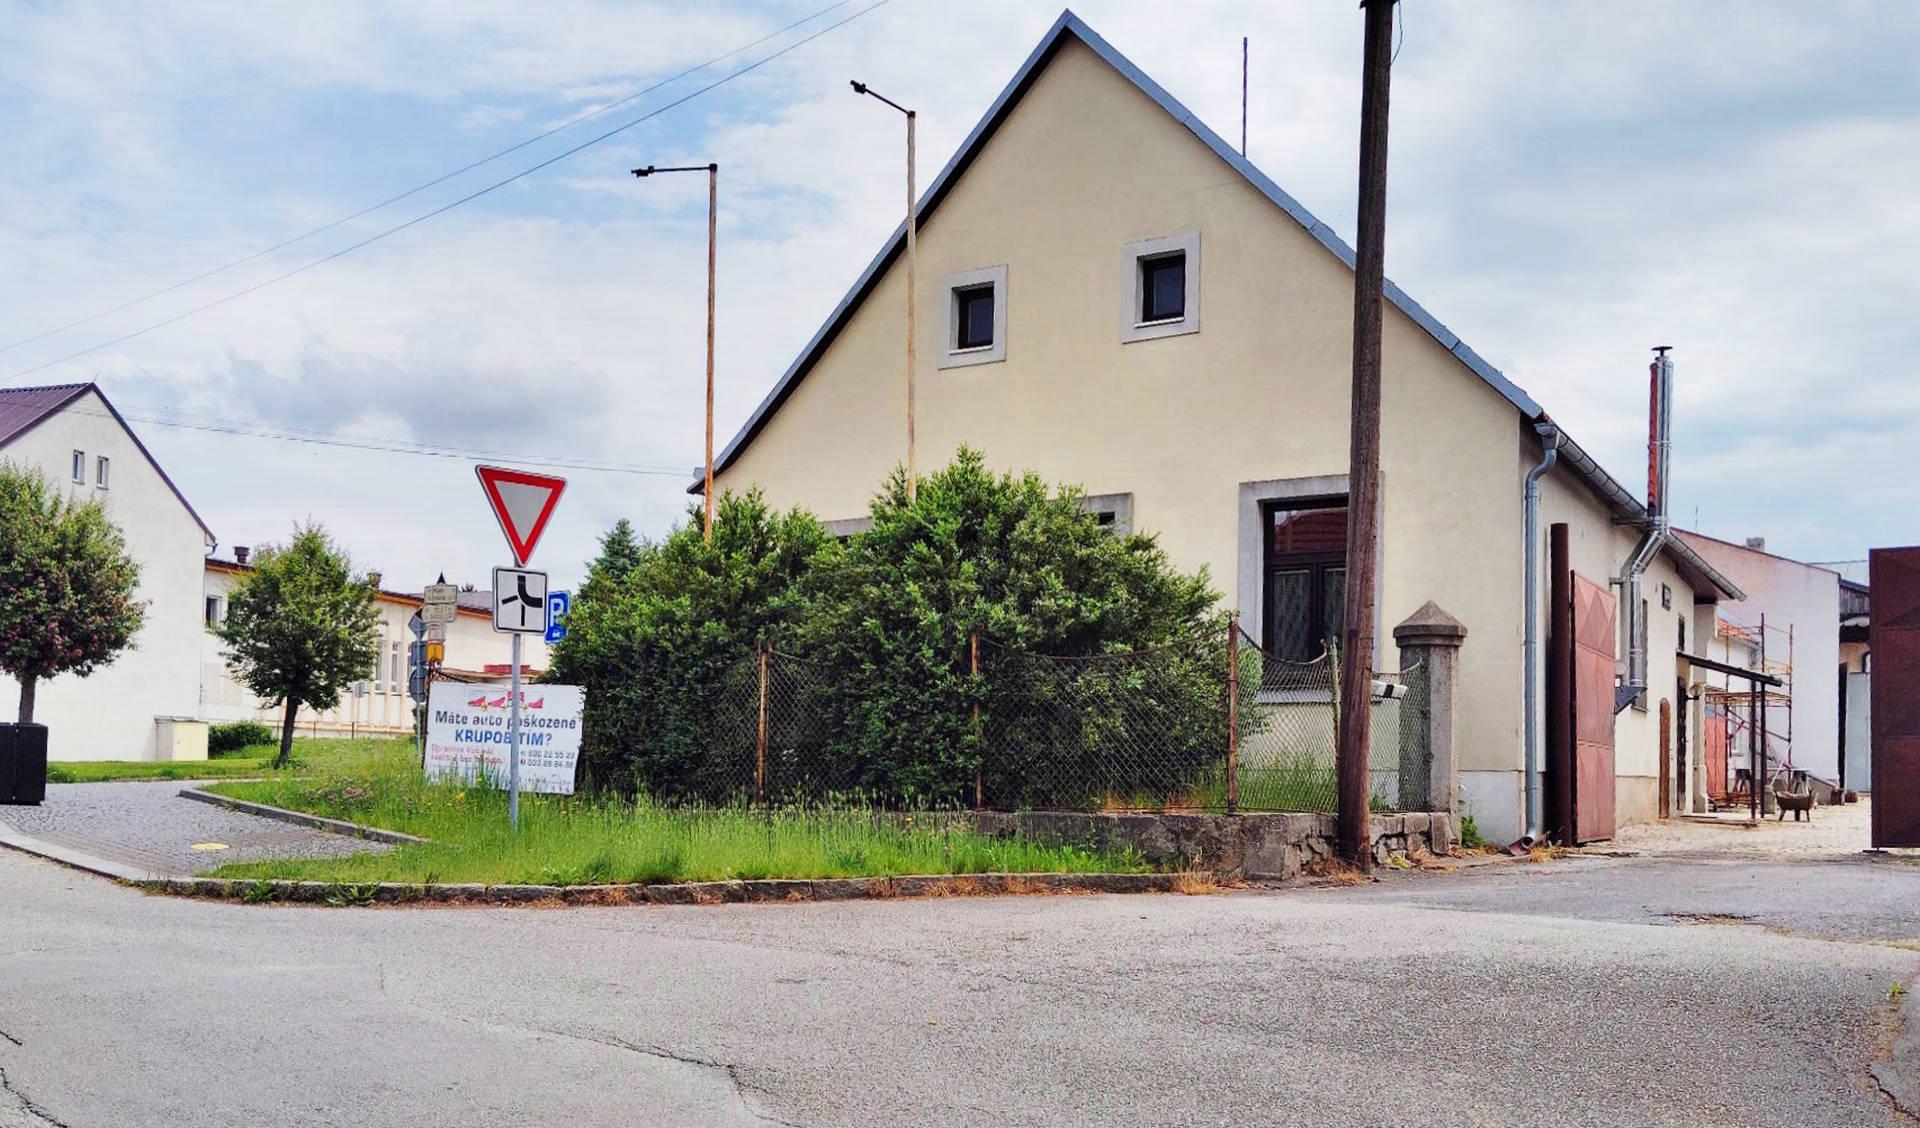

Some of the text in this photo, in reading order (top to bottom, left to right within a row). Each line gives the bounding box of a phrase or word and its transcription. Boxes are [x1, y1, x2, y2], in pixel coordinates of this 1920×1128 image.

[549, 597, 564, 627] P
[435, 710, 468, 725] Máte
[472, 714, 503, 727] auto
[455, 729, 552, 746] KRUPOBTÍM?
